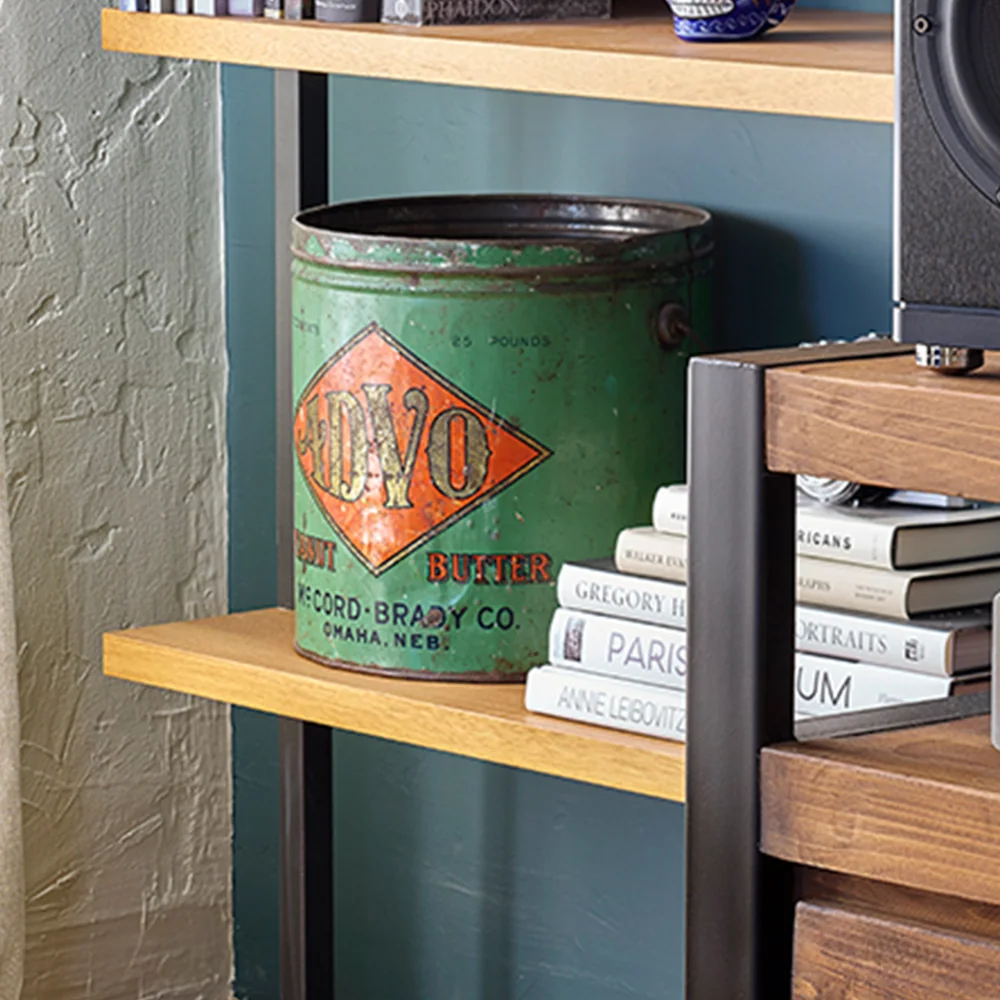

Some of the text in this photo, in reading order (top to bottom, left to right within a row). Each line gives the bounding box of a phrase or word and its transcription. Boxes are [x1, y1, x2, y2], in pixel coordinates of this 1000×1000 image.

[488, 334, 552, 348] POUNDS
[797, 529, 853, 551] RICANS
[427, 552, 553, 584] BUTTER
[625, 549, 663, 565] WALKER
[575, 580, 664, 613] GREGORY
[477, 606, 520, 630] CO.
[796, 619, 888, 654] ORTRAITS
[608, 631, 687, 677] PARIS
[557, 685, 607, 717] ANNIE
[797, 667, 852, 708] UM
